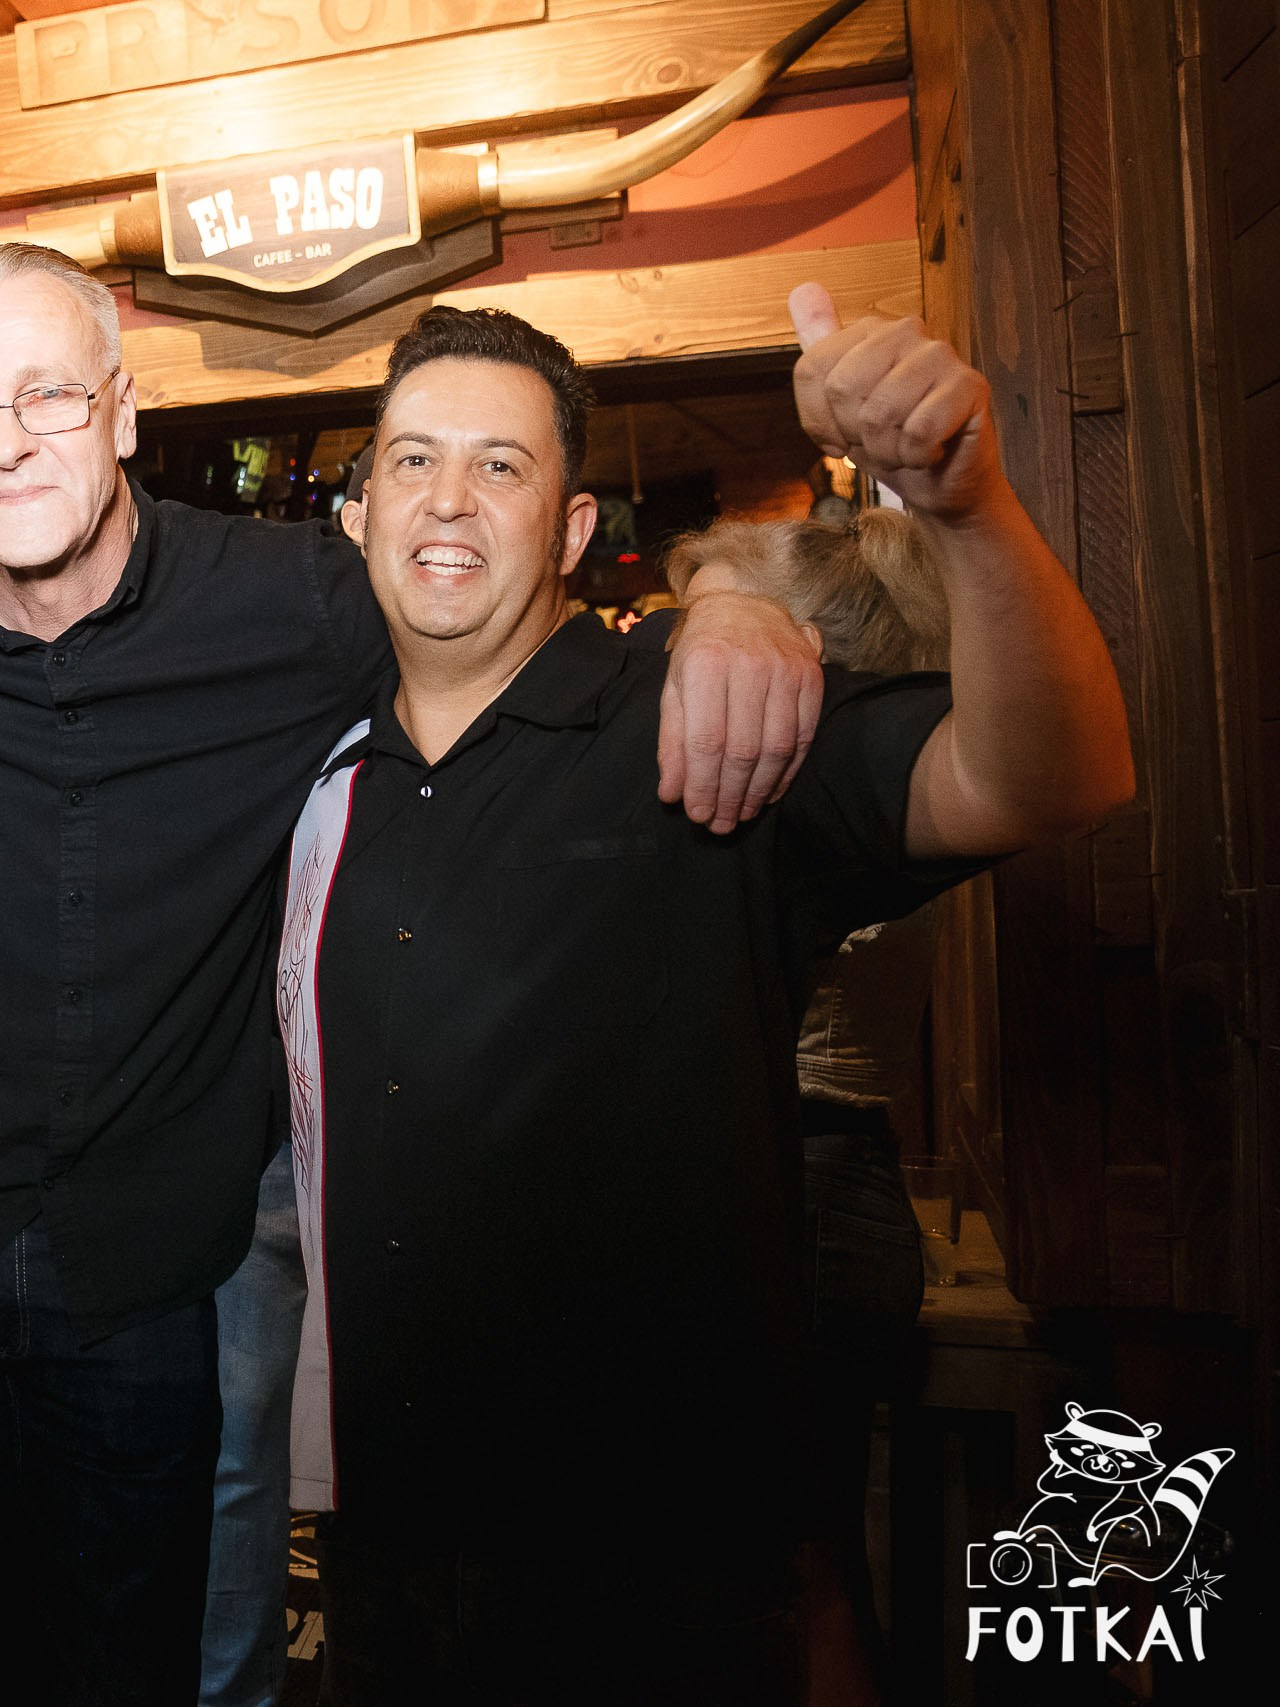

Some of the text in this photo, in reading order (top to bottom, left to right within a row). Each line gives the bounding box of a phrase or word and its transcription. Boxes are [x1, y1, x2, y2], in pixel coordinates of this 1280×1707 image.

[187, 167, 384, 259] EL PASO
[305, 243, 333, 260] BAR
